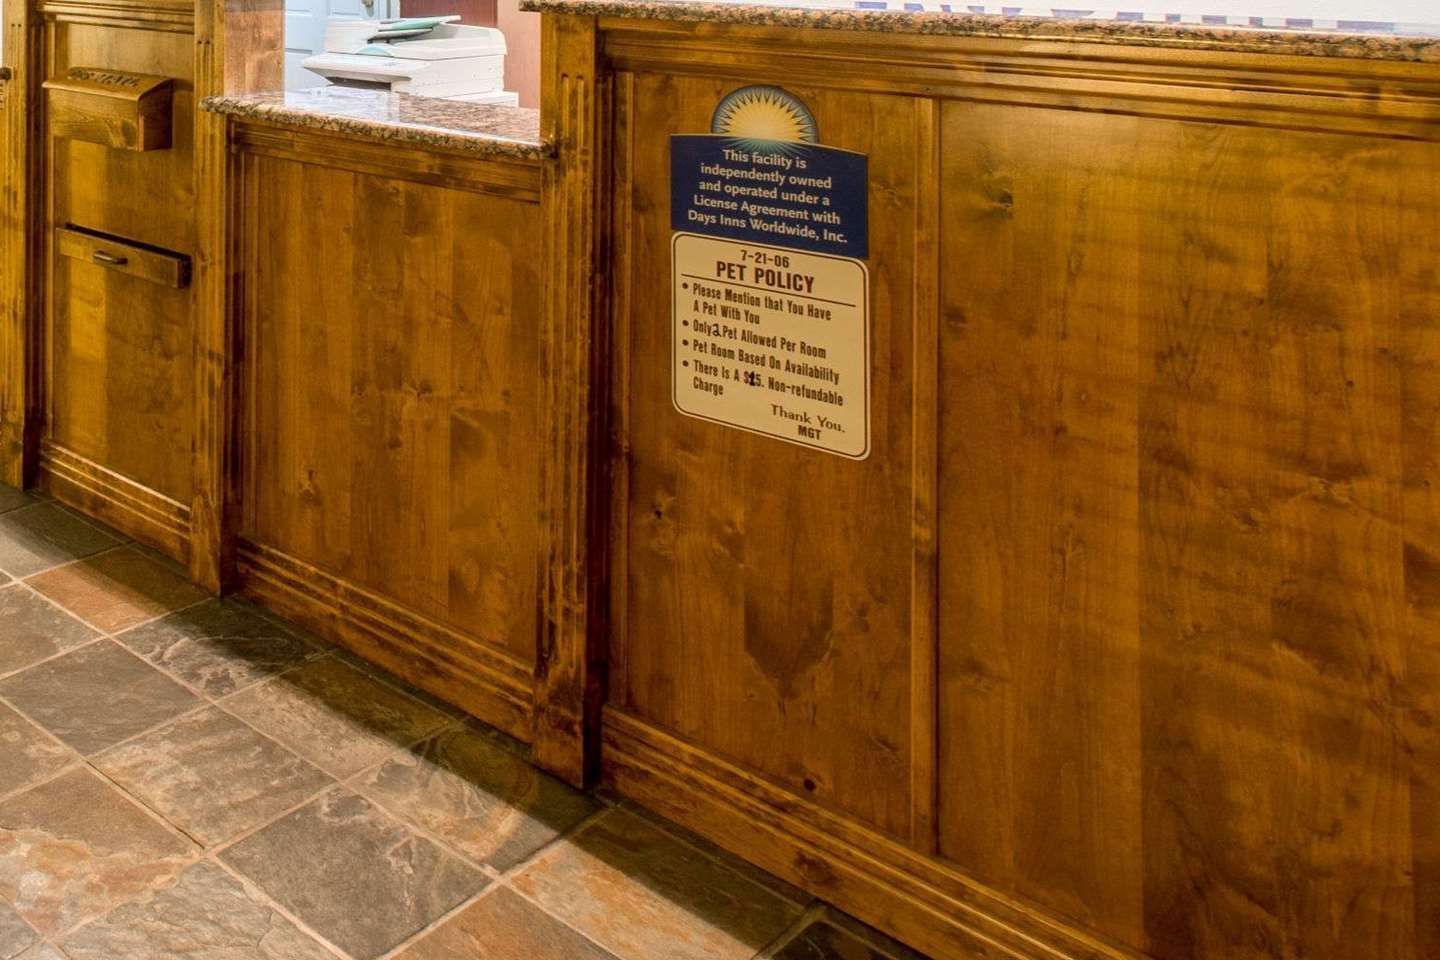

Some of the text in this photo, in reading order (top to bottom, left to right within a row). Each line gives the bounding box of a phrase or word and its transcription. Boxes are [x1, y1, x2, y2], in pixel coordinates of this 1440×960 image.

[722, 149, 807, 169] This facility is
[700, 163, 832, 189] independently owned
[699, 180, 830, 206] and operated under a
[693, 195, 841, 225] License Agreement with
[688, 209, 848, 243] Days Inns Worldwide, Inc.
[740, 249, 790, 268] 7-21-06
[716, 261, 815, 293] PET POLICY
[693, 283, 832, 321] Please Mention that You Have
[693, 300, 760, 325] A Pet With You
[693, 319, 711, 336] Only
[722, 325, 737, 340] Pet
[741, 329, 777, 348] Allowed
[780, 337, 796, 352] Per
[800, 341, 827, 359] Room
[693, 339, 840, 386] Pet Room Based On Availability
[693, 360, 718, 377] There
[721, 366, 730, 379] Is
[733, 369, 740, 382] A
[768, 376, 844, 407] Non-refundable
[693, 376, 724, 396] Charge
[770, 403, 846, 433] Thank You.
[797, 424, 822, 441] MGT
